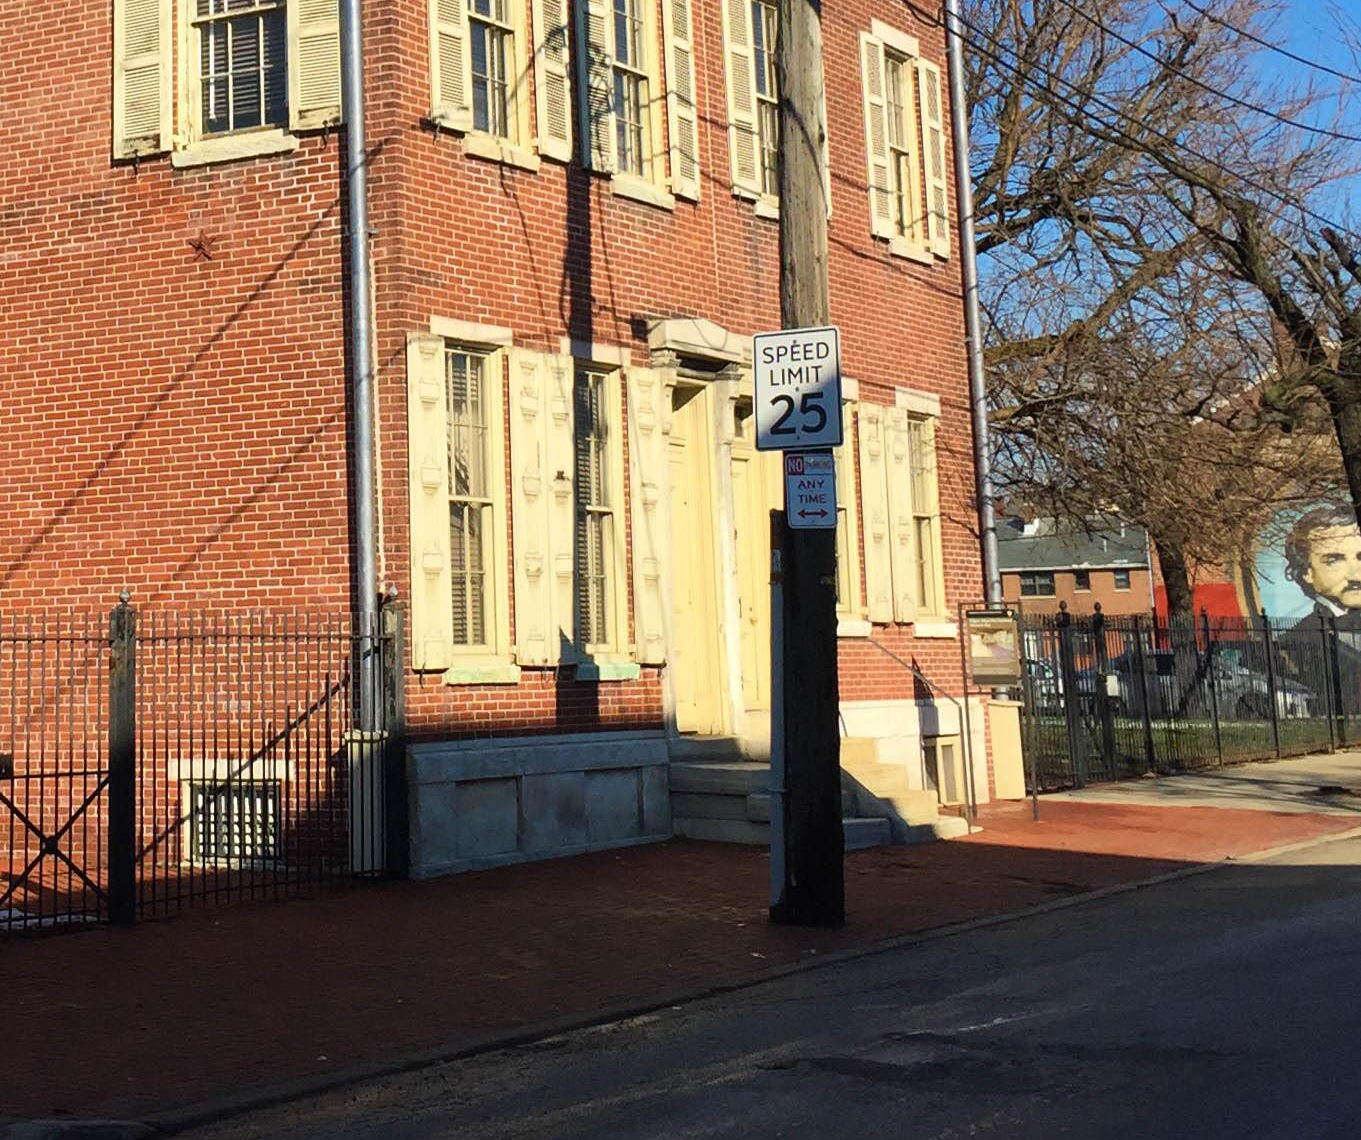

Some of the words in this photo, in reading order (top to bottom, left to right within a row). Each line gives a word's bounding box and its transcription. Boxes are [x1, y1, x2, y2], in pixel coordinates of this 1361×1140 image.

[762, 341, 830, 364] SPEED
[769, 365, 822, 386] LIMIT
[769, 392, 827, 435] 25
[788, 458, 803, 473] NO
[798, 479, 825, 489] ANY
[798, 493, 827, 504] TIME
